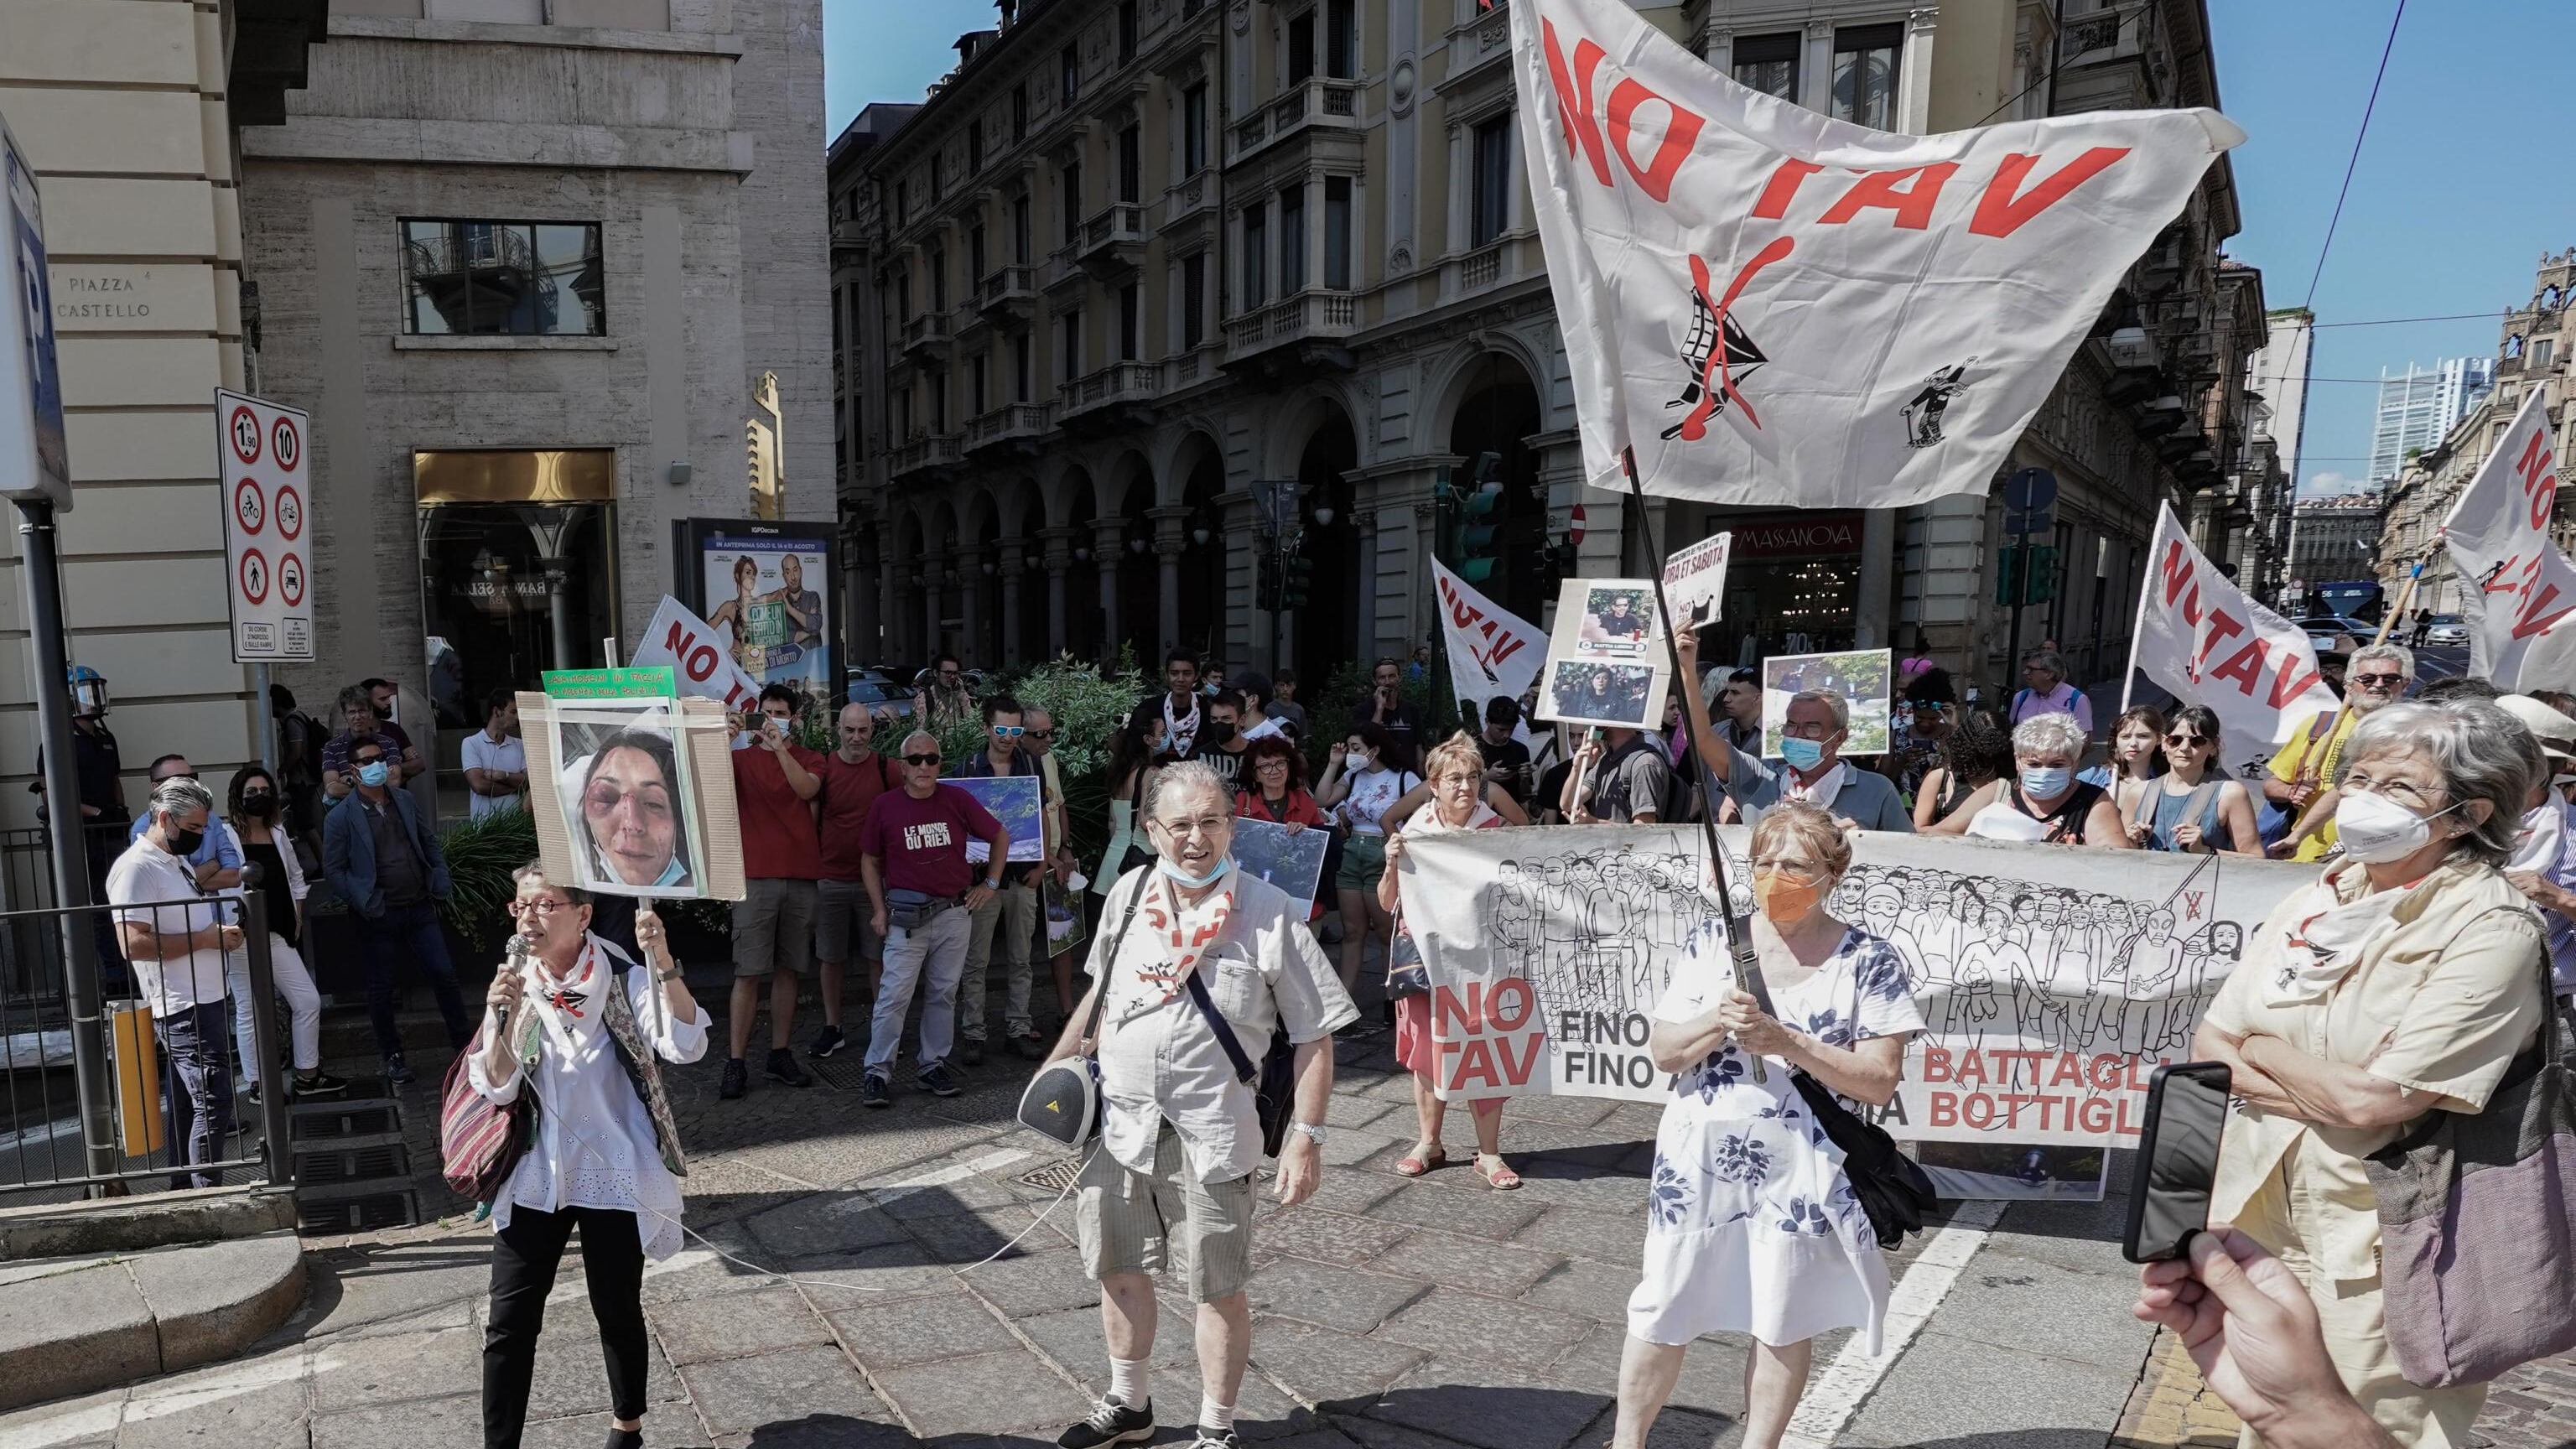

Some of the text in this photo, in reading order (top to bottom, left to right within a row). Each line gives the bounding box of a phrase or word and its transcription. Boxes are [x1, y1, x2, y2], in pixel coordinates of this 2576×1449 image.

[1542, 15, 2132, 239] NO TAV
[70, 278, 133, 291] PIAZZA
[57, 304, 149, 317] CASTELLO
[279, 428, 293, 460] 10
[2516, 427, 2557, 532] NO
[1737, 525, 1852, 549] MASSANOVA
[1665, 564, 1680, 586] ORA
[1680, 559, 1690, 579] ET
[1691, 545, 1723, 574] SABOTA
[664, 620, 719, 683] NO
[2199, 607, 2323, 710] TAV
[613, 673, 623, 683] IN
[631, 673, 664, 683] FACCIA
[917, 823, 949, 836] MONDE
[924, 832, 952, 848] RIEN
[1435, 977, 1535, 1036] NO
[1561, 1010, 1650, 1047] FINO
[1435, 1032, 1547, 1091] TAV
[1565, 1051, 1654, 1089] FINO
